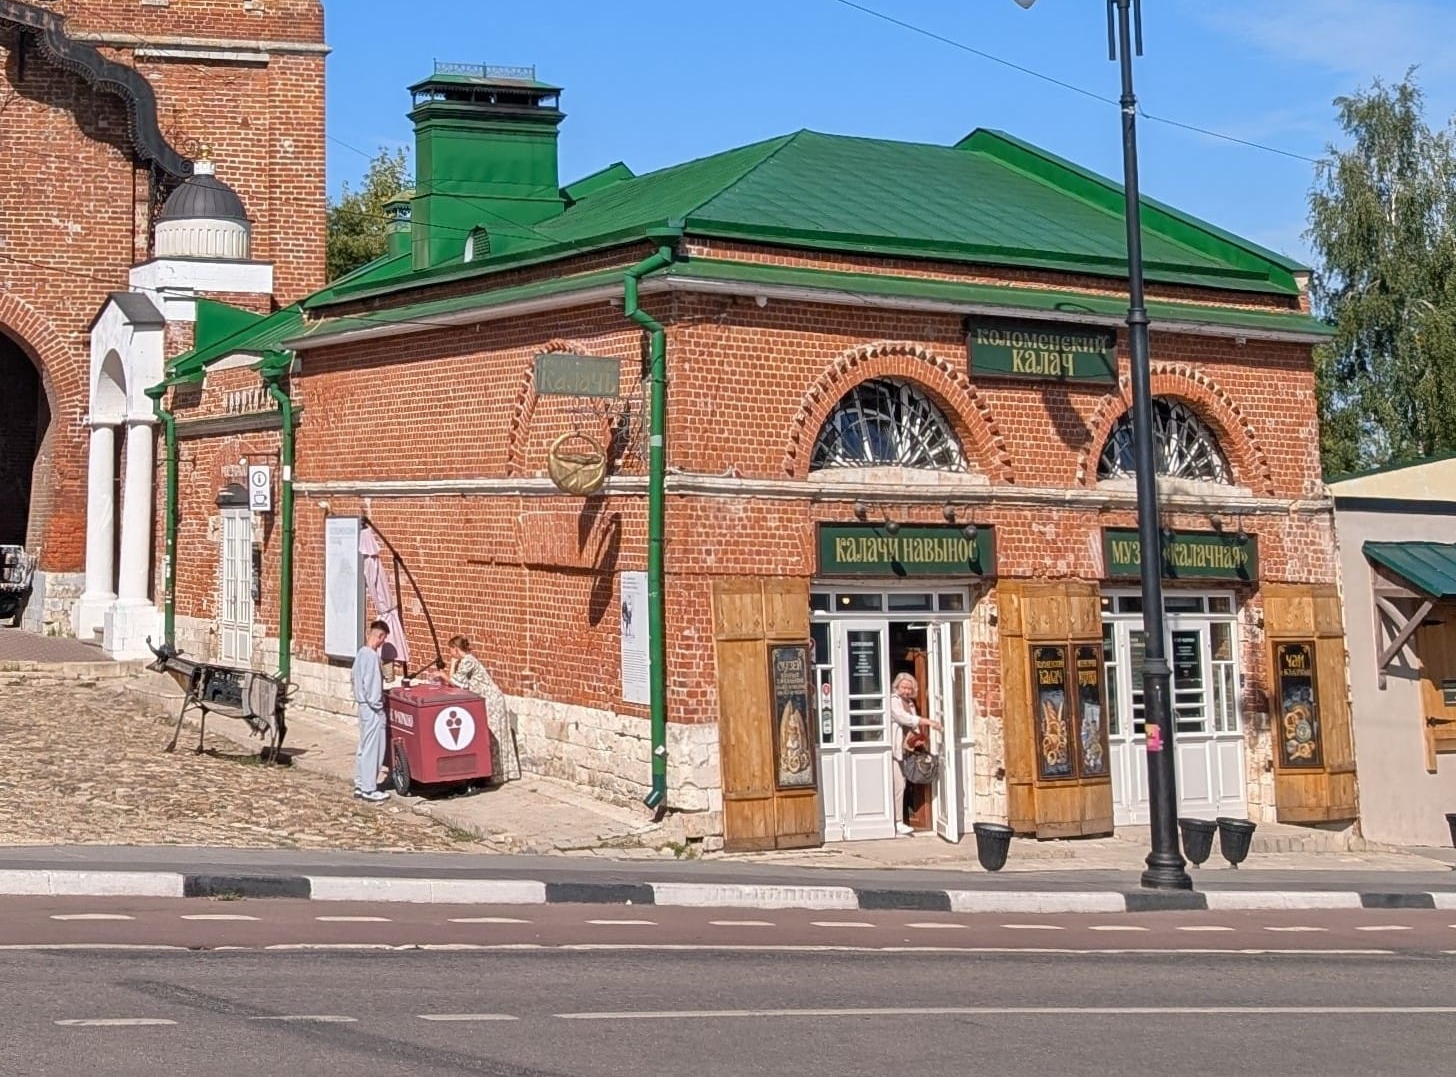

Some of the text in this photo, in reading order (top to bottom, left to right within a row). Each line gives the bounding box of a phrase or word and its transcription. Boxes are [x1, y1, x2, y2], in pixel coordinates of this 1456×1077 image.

[976, 328, 1110, 354] КОЛОМЕНСКИЙ
[1012, 348, 1075, 377] КАЛАЧ
[1112, 540, 1141, 565] МУЗ
